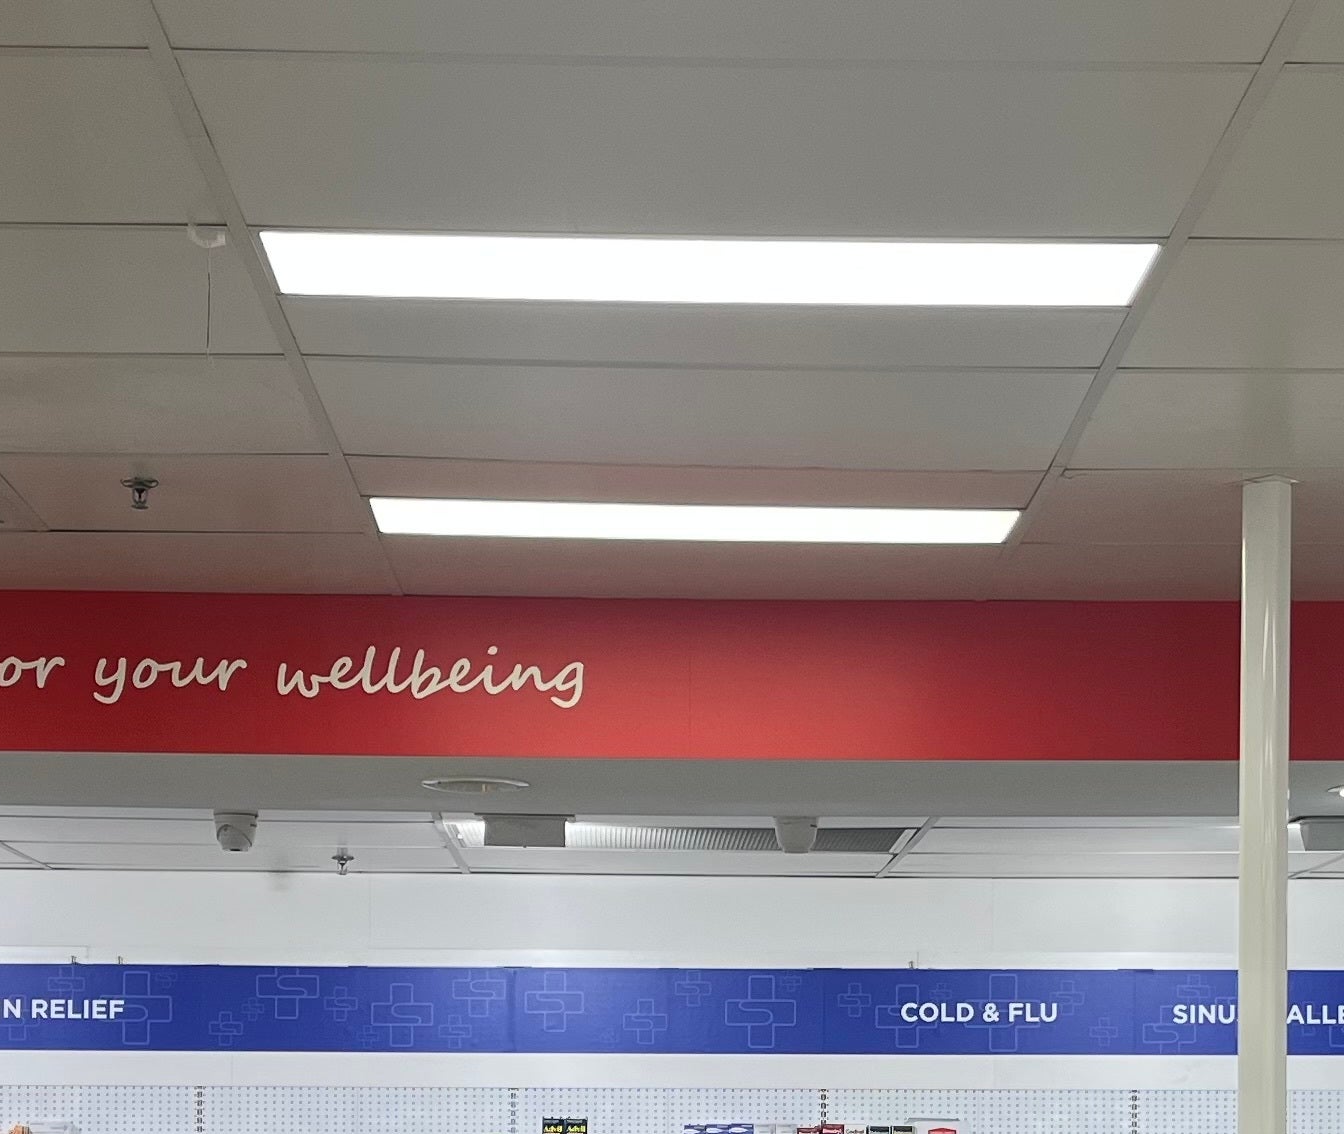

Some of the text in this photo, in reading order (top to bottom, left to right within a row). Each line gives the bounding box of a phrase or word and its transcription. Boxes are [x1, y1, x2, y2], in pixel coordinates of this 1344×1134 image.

[92, 651, 247, 706] your
[275, 645, 587, 708] wellbeing
[50, 999, 126, 1021] RELIEF
[901, 1002, 1058, 1022] COLD & FLU
[1173, 1004, 1239, 1025] SINU
